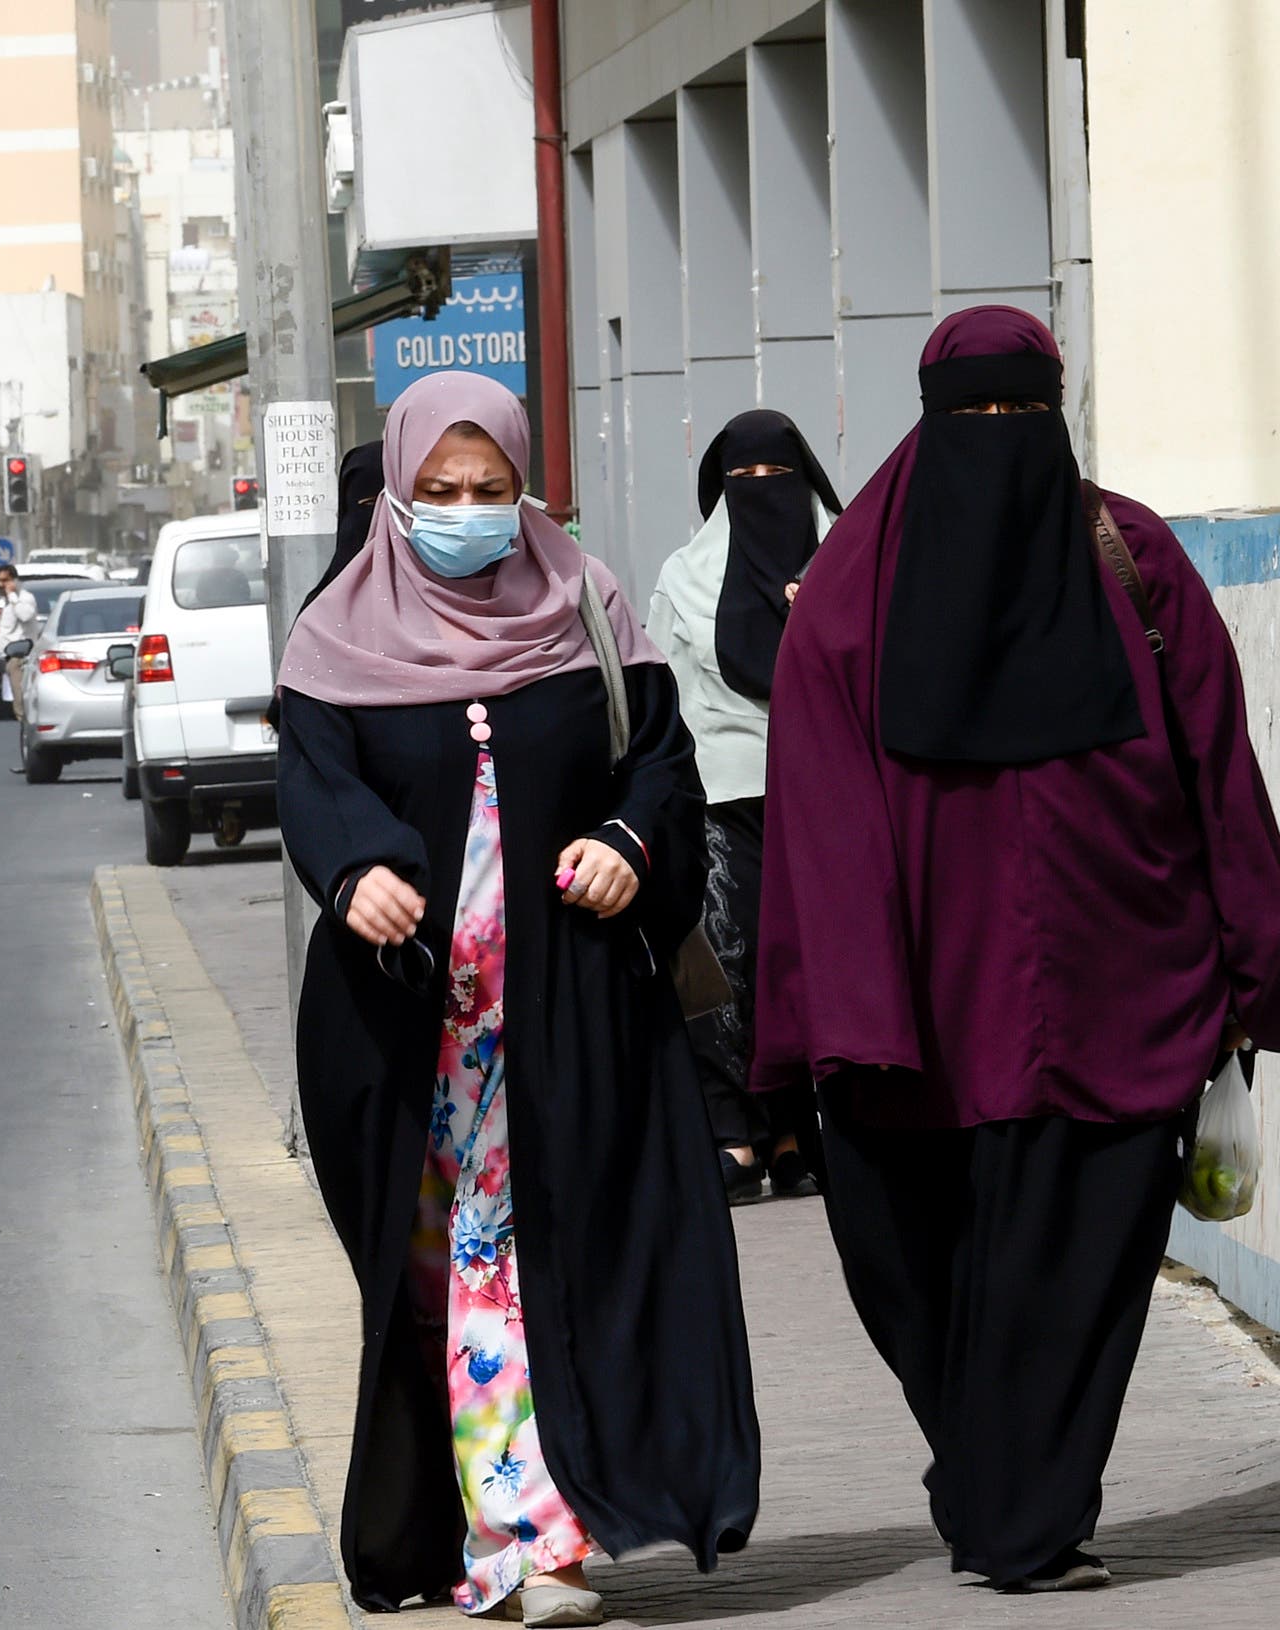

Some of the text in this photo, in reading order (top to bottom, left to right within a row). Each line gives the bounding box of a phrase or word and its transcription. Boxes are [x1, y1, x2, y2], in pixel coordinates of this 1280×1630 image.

[396, 335, 455, 368] COLD
[268, 413, 334, 428] SHIFTING
[276, 430, 324, 443] HOUSE
[282, 446, 318, 458] FLAT
[276, 462, 325, 474] OFFICE
